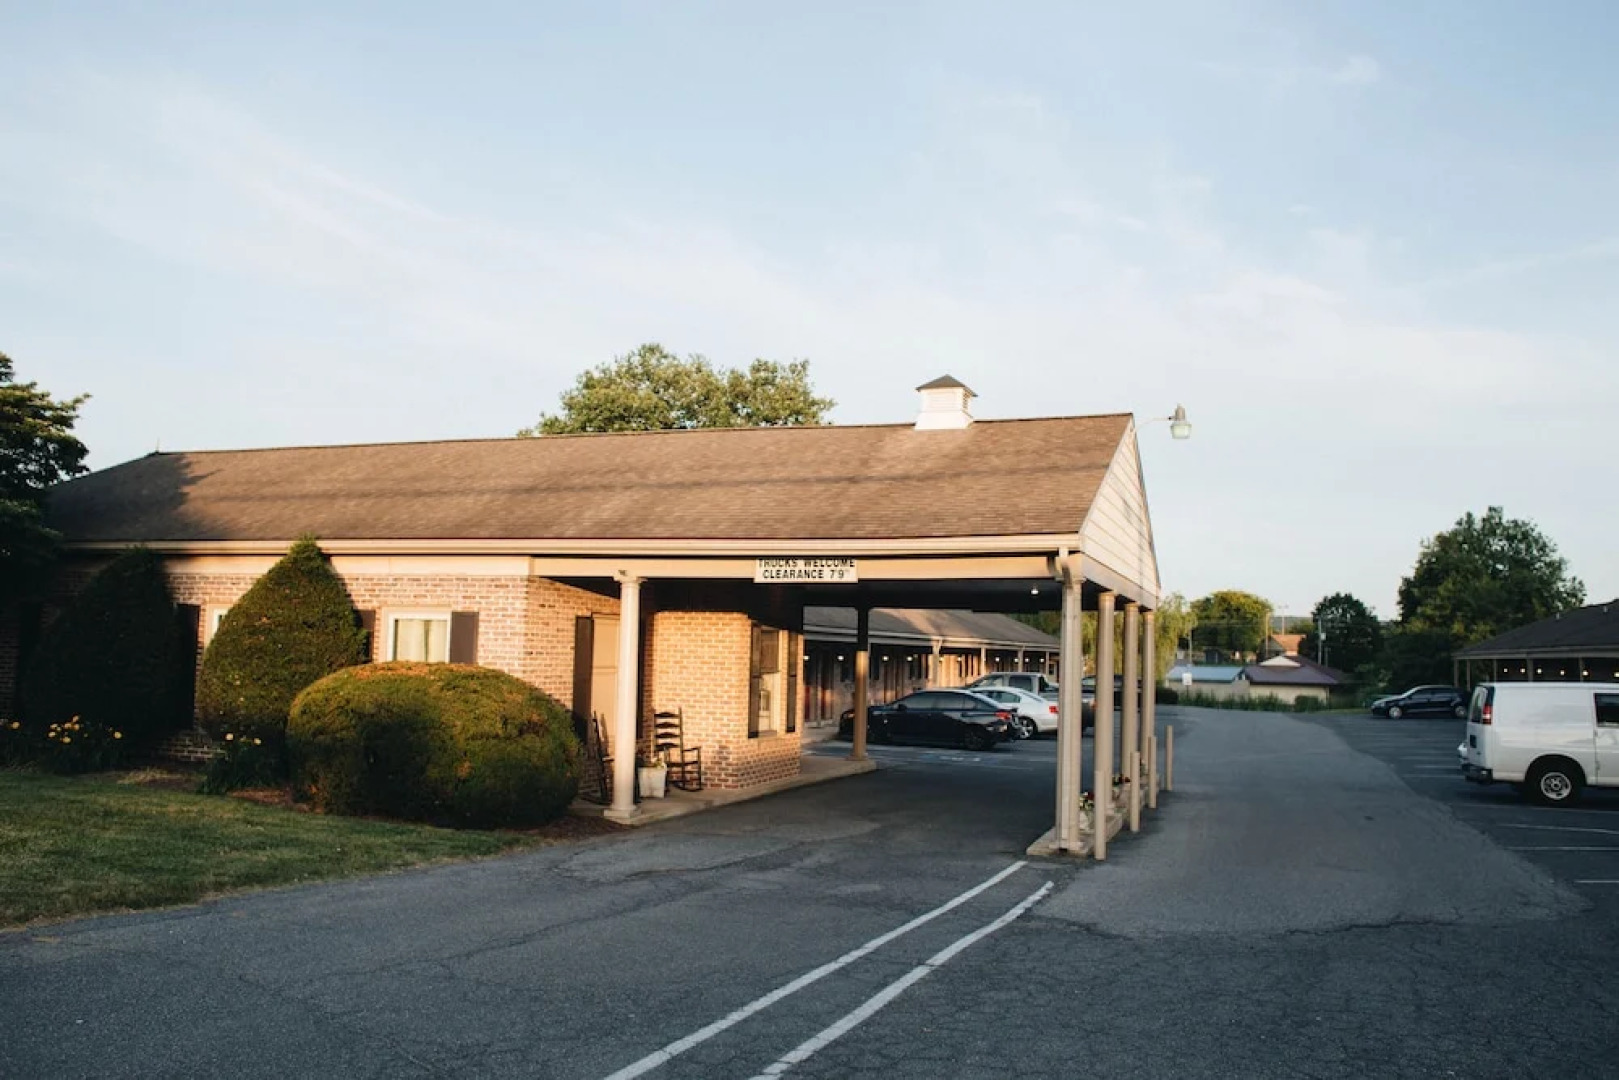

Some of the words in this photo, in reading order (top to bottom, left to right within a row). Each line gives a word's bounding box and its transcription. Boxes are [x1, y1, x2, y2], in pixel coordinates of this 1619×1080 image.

[758, 558, 798, 567] TRUCKS
[804, 558, 855, 567] WELCOME
[763, 569, 824, 579] CLEARANCE
